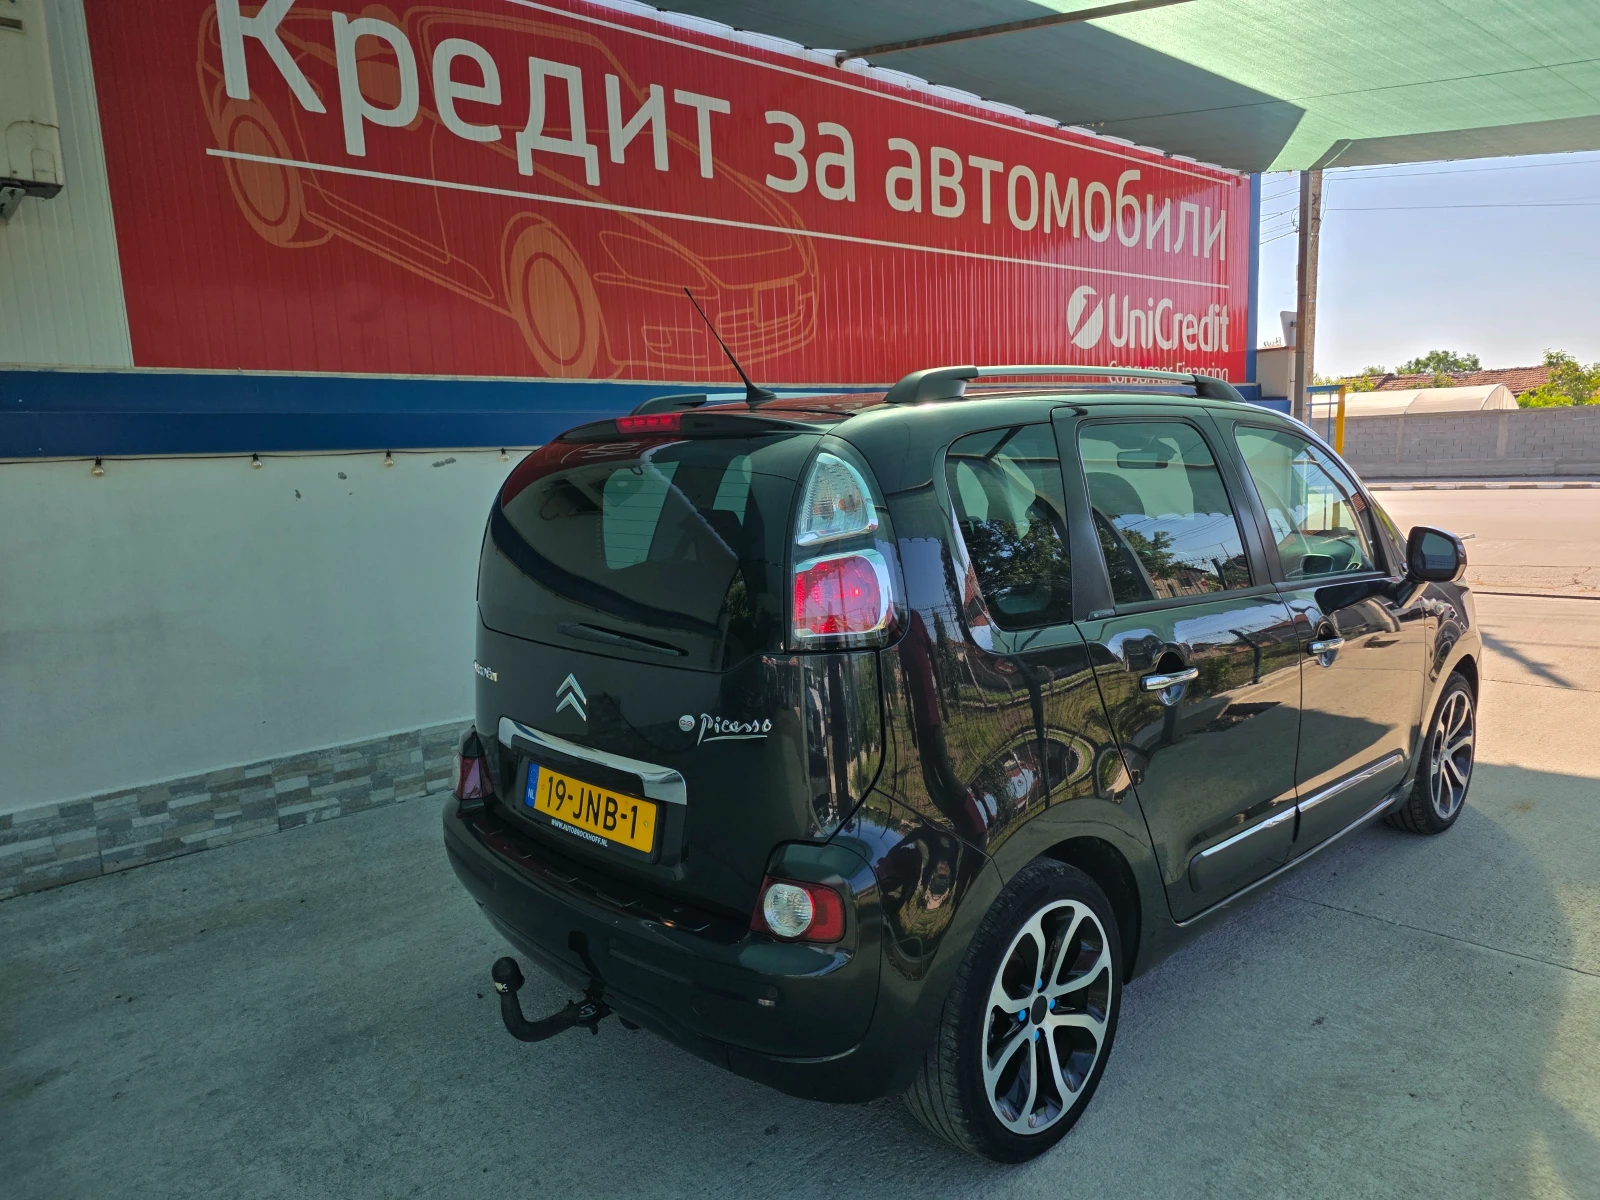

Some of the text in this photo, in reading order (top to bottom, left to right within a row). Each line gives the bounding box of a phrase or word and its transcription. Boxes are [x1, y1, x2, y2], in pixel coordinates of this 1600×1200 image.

[216, 0, 1227, 261] Кредит за автомобили
[1108, 293, 1230, 353] UniCredit
[697, 713, 772, 746] Picasso
[527, 776, 638, 840] NL 19-JNB-1
